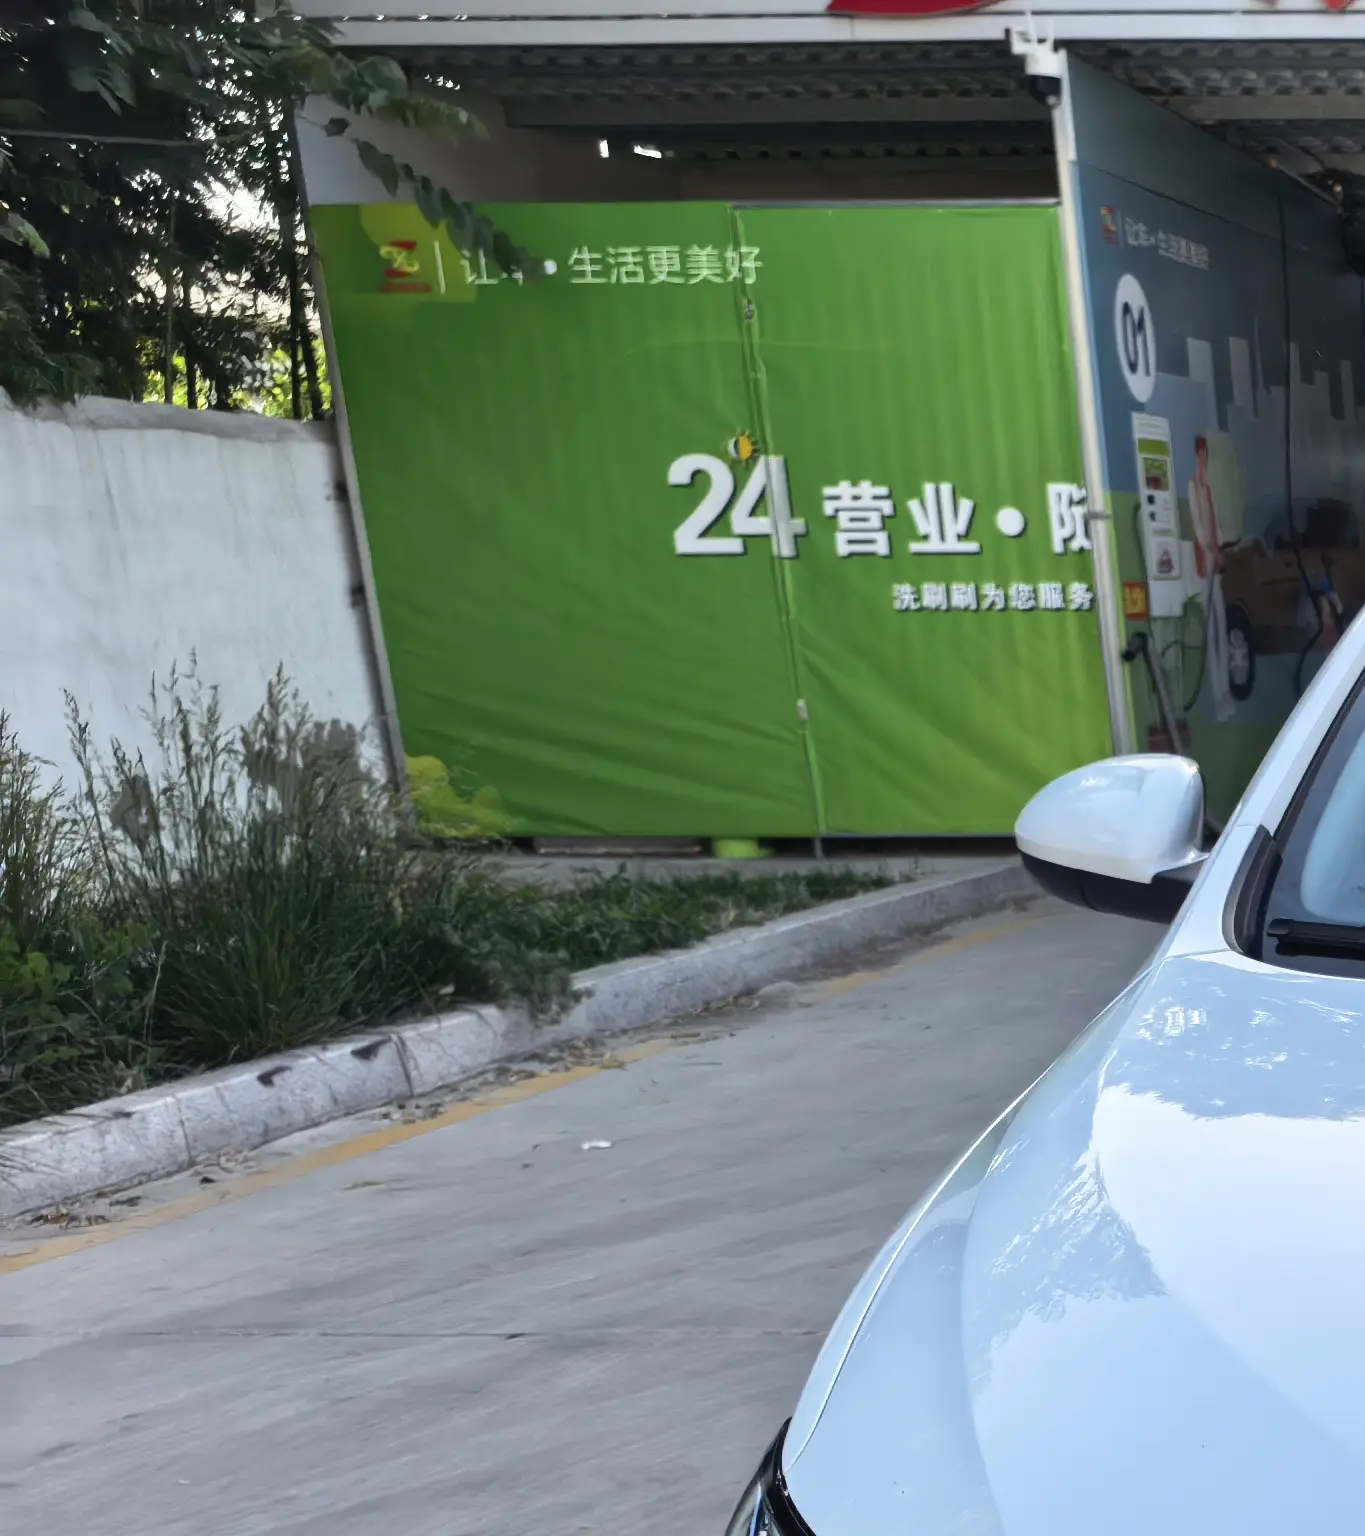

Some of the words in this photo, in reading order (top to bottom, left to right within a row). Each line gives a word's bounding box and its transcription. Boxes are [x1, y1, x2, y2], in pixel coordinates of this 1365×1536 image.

[1123, 301, 1151, 377] 01
[668, 453, 807, 558] 24
[893, 582, 1094, 611] 洗刷刷为您服务
